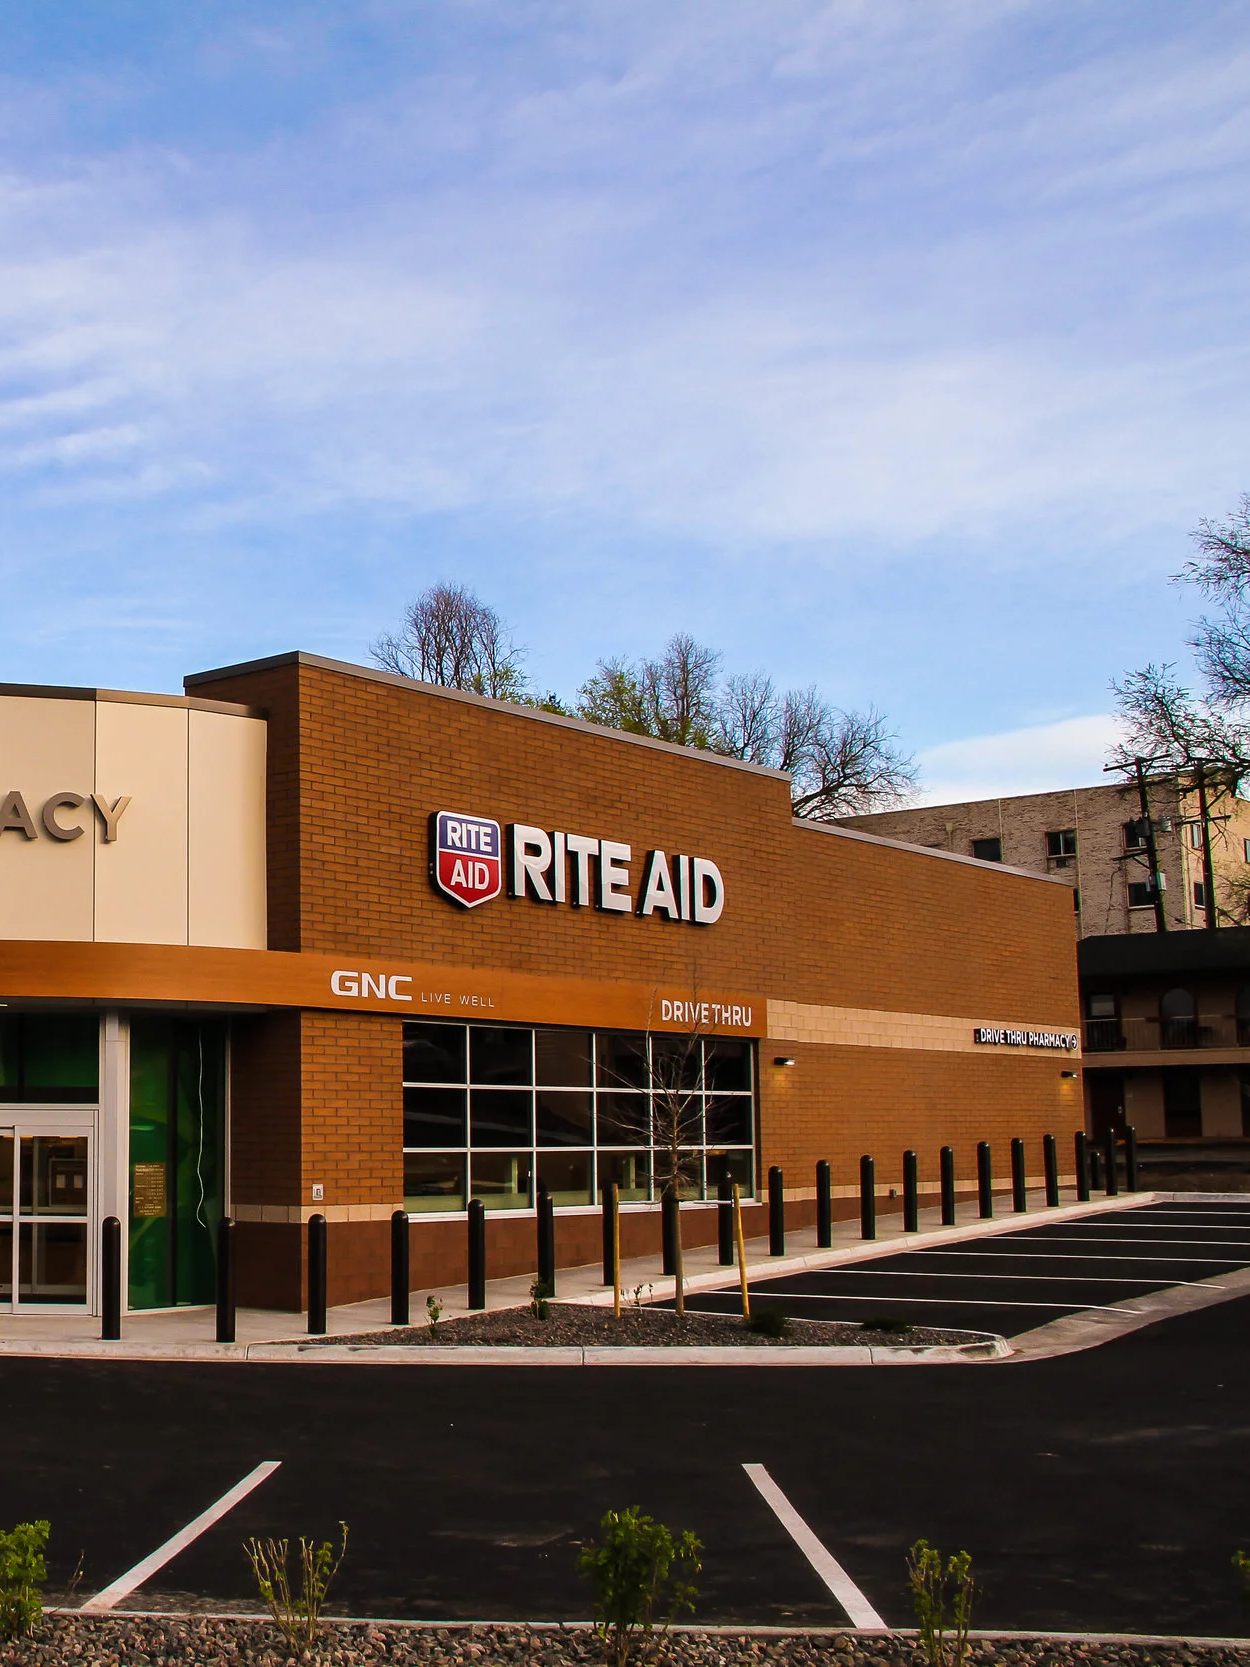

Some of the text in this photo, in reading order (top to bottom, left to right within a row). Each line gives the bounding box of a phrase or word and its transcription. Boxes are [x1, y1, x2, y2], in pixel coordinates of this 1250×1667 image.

[446, 820, 492, 852] RITE
[450, 859, 490, 890] AID
[513, 823, 725, 924] RITE AID
[330, 970, 495, 1008] GNC LIVE WELL
[661, 999, 752, 1027] DRIVE THRU
[980, 1028, 1071, 1048] DRIVE THRU PHARMACY
